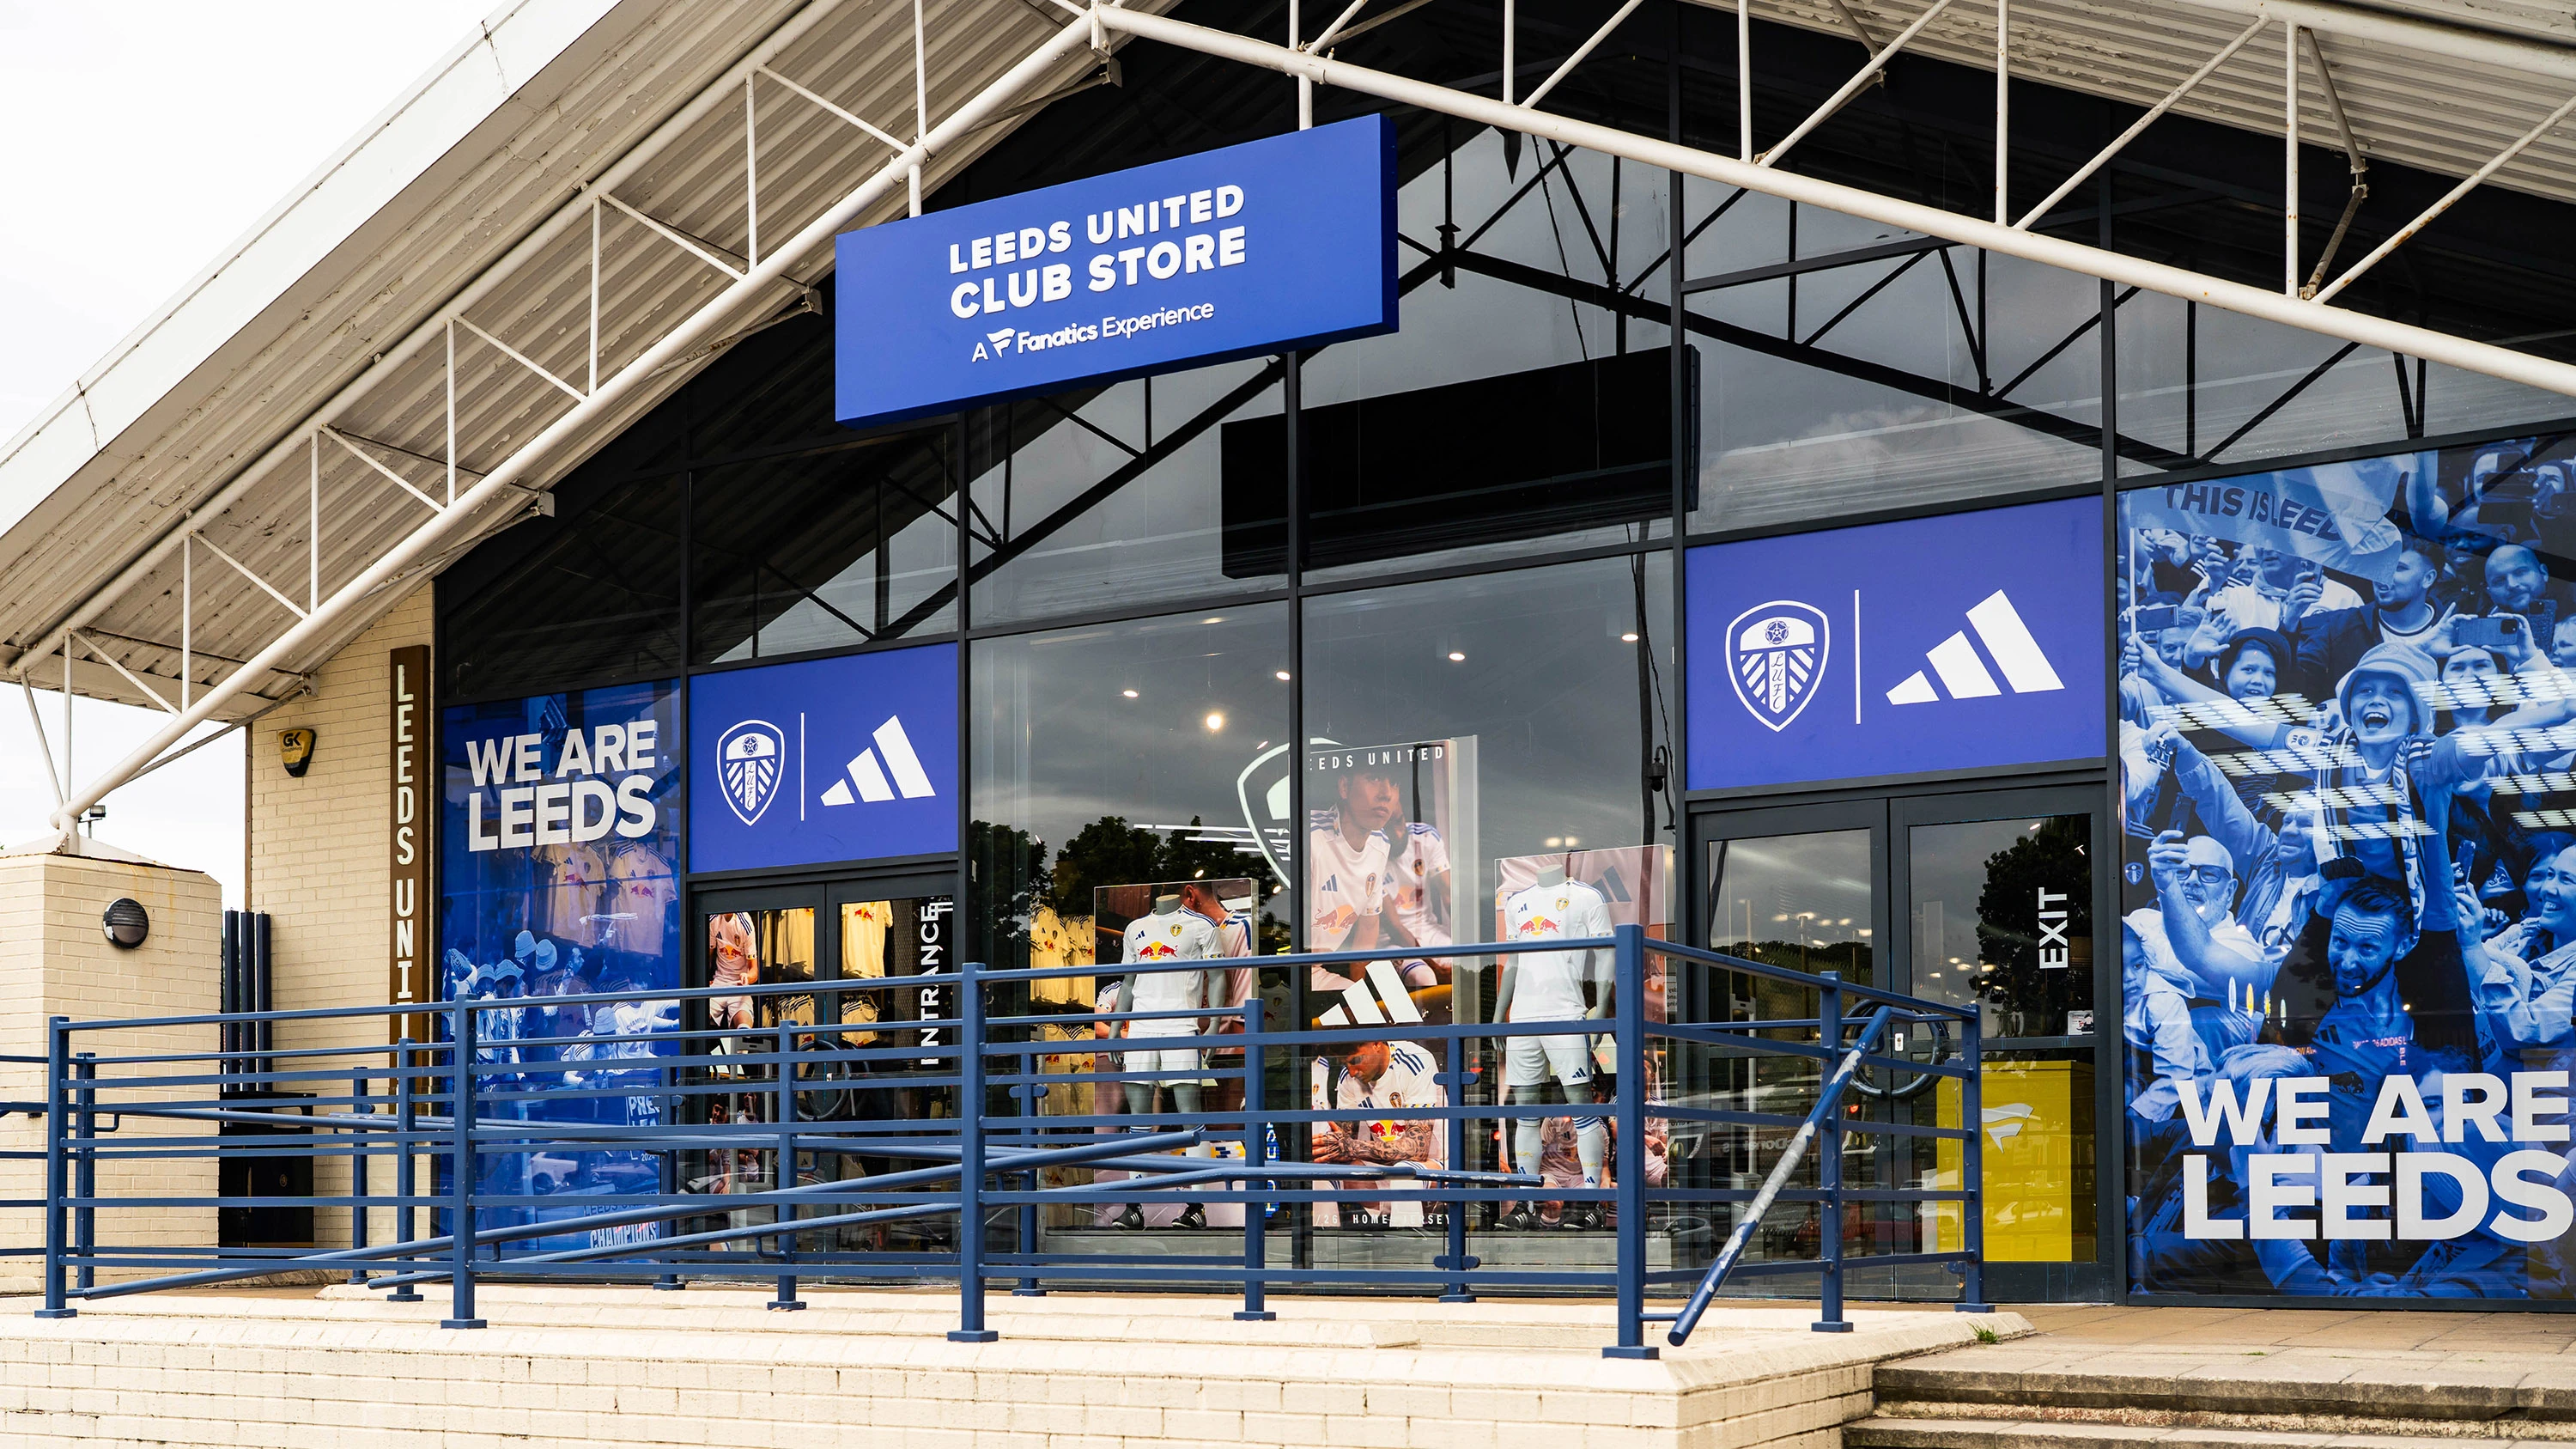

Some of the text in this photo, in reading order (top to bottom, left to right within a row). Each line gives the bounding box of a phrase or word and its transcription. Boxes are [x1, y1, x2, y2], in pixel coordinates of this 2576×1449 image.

[950, 185, 1244, 274] LEEDS UNITED
[951, 225, 1246, 319] CLUB STORE
[971, 302, 1215, 362] A Fanatics Experience
[2162, 483, 2342, 542] THIS IS LEED
[1771, 653, 1783, 709] LUFC
[283, 732, 301, 747] GK
[465, 719, 655, 787] WE ARE
[1309, 746, 1443, 770] EDS UNITED
[469, 774, 656, 852] LEEDS
[397, 664, 414, 1115] LEEDS UNIT
[2038, 887, 2068, 969] EXIT
[2175, 1070, 2570, 1146] WE ARE
[1352, 1214, 1388, 1224] HOME
[2183, 1149, 2574, 1242] LEEDS
[590, 1221, 657, 1248] CHAMPIONS
